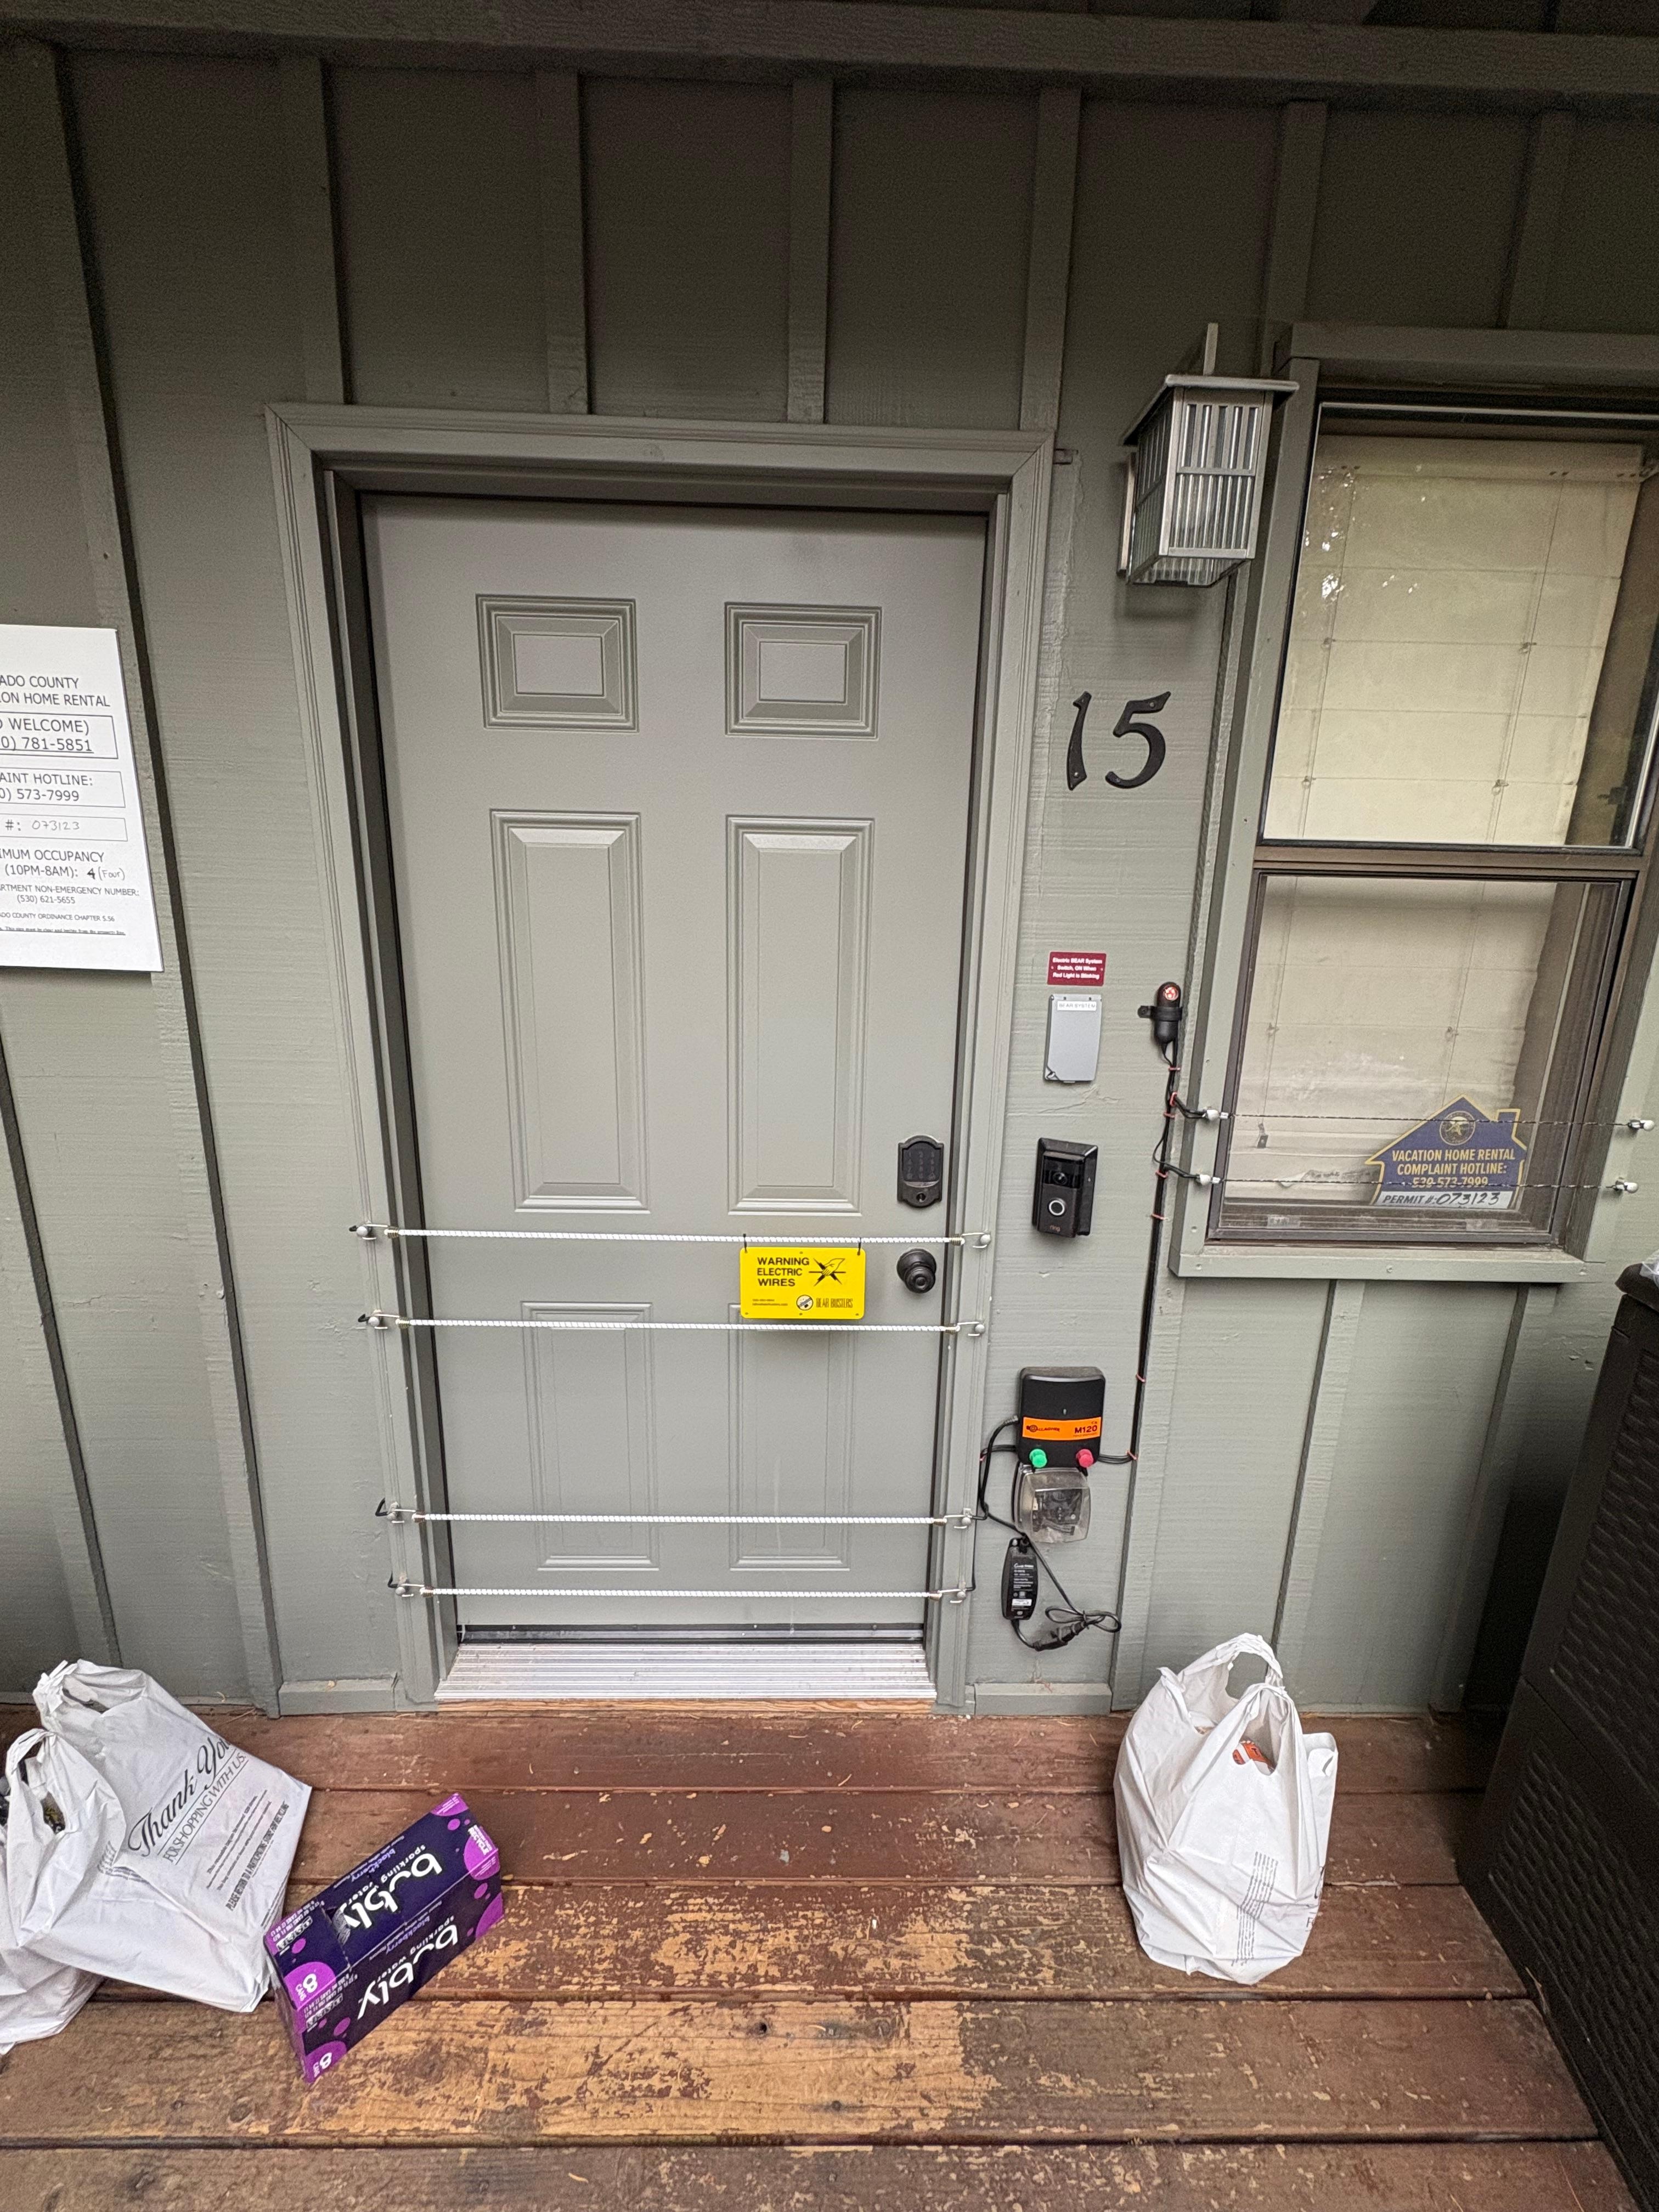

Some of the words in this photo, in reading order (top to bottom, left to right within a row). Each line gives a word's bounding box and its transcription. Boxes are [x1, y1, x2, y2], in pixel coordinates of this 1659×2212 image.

[30, 676, 79, 689] COUNTY
[0, 692, 19, 703] ON
[24, 693, 60, 705] HOME
[64, 694, 110, 707] RENTAL
[8, 718, 89, 736] WELCOME)
[21, 737, 92, 751] 781-5851
[1066, 691, 1171, 791] 15
[33, 773, 93, 786] HOTLINE:
[17, 789, 79, 802] 573-7999
[32, 820, 80, 831] 073123
[35, 850, 104, 862] OCCUPANCY
[5, 864, 78, 878] (10PM-8AM):
[87, 868, 95, 879] 4
[35, 885, 101, 894] NON-EMERGENCY
[105, 887, 139, 896] NUMBER:
[17, 894, 37, 904] (530)
[40, 895, 75, 904] 621-5655
[1392, 1150, 1442, 1161] VACATION
[1444, 1149, 1475, 1161] HOME
[1477, 1149, 1515, 1160] RENTAL
[1397, 1163, 1457, 1175] COMPLAINT
[1460, 1162, 1507, 1174] HOTLINE:
[1412, 1177, 1488, 1188] 5305737999
[1382, 1195, 1425, 1204] PERMIT
[757, 1257, 809, 1266] WARNING
[757, 1268, 803, 1276] ELECTRIC
[758, 1278, 795, 1286] WIRES
[831, 1298, 853, 1308] BUSTERS
[1075, 1425, 1097, 1434] M120
[128, 1769, 197, 1858] Thank
[173, 1795, 214, 1848] SHOPPING
[467, 1826, 489, 1855] RECYCLE
[380, 1844, 426, 1883] sparkling
[409, 1915, 454, 1954] sparkling
[357, 1923, 459, 2019] bubly
[376, 1956, 406, 1982] water
[303, 1973, 318, 1993] 8
[295, 1983, 306, 2001] CANS
[319, 2051, 334, 2070] 8
